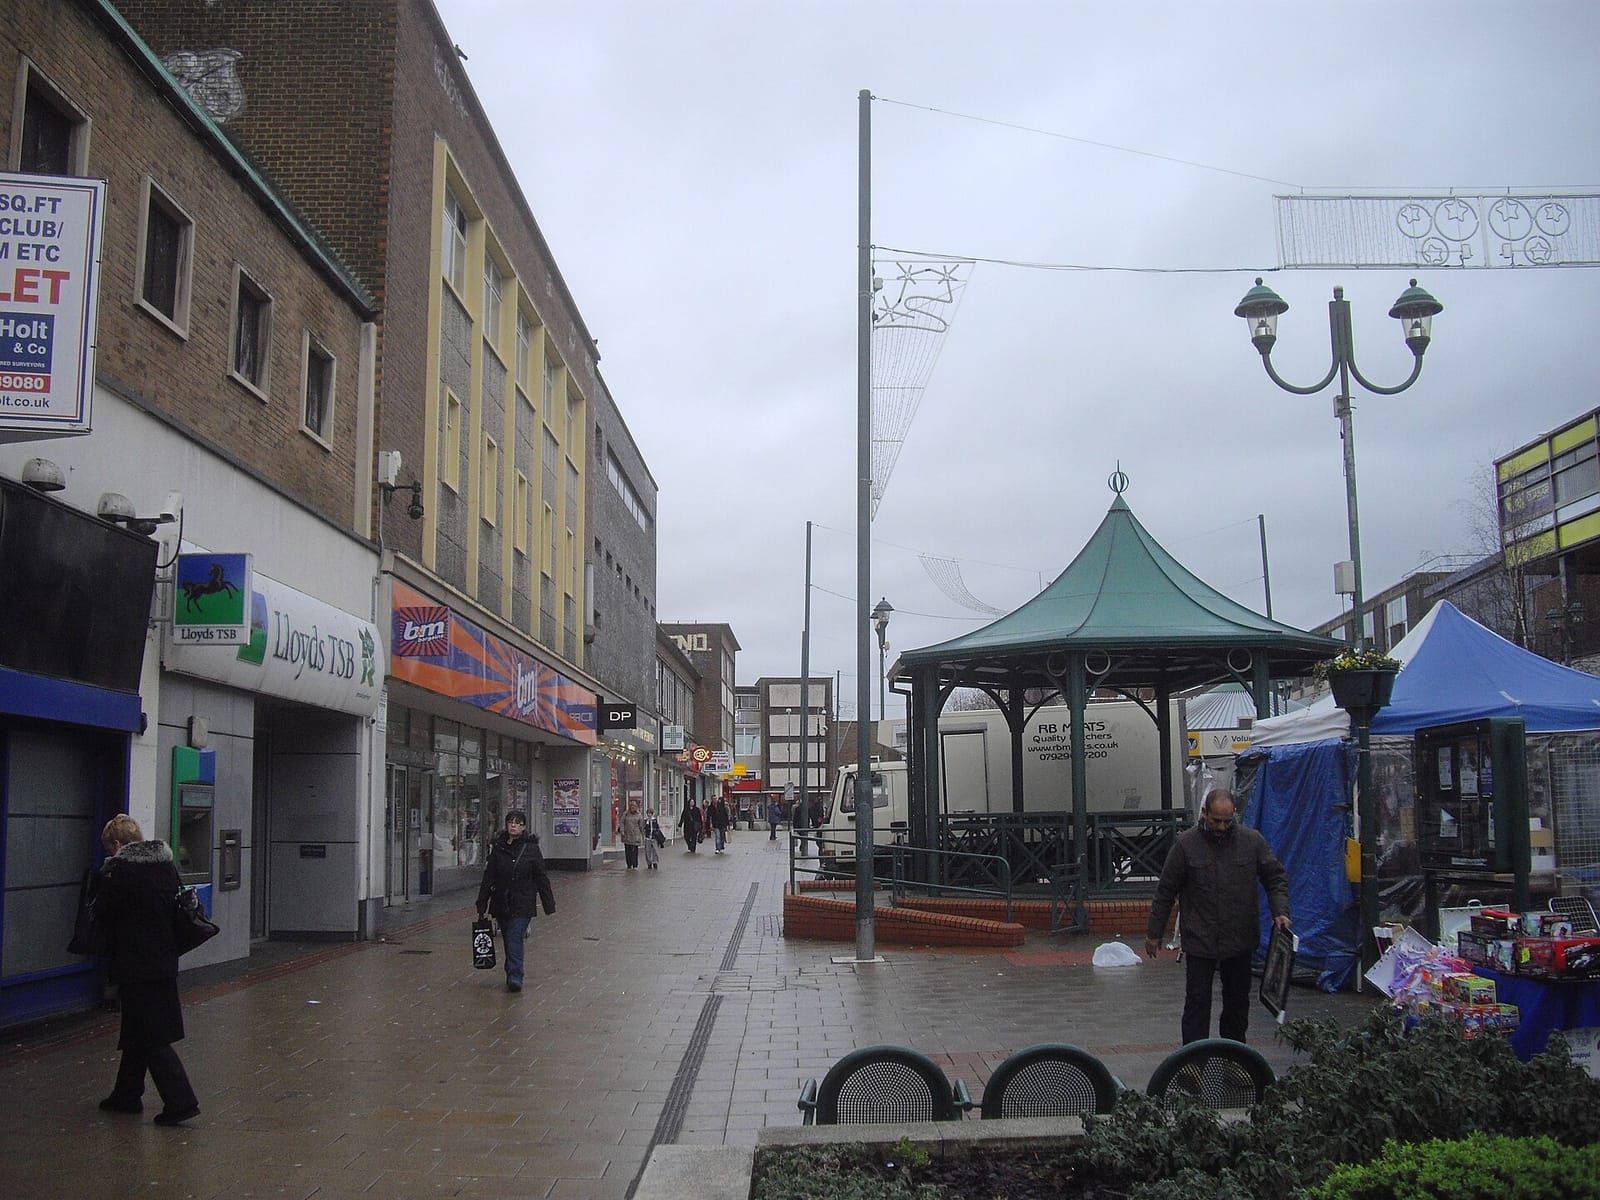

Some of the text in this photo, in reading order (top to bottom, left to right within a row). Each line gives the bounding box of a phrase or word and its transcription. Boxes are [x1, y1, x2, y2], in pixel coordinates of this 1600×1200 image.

[0, 194, 62, 213] SQ.FT
[0, 218, 64, 239] CLUB/
[17, 243, 60, 262] ETC
[0, 319, 48, 339] Holt
[13, 342, 46, 354] & Co
[0, 376, 44, 390] 9080
[0, 395, 50, 408] lt.co.uk
[182, 628, 236, 642] Lloyds TSB
[273, 611, 354, 680] Lloyds TSB
[609, 711, 632, 721] DP
[1039, 721, 1105, 733] RB MATS
[1033, 735, 1066, 743] Quality
